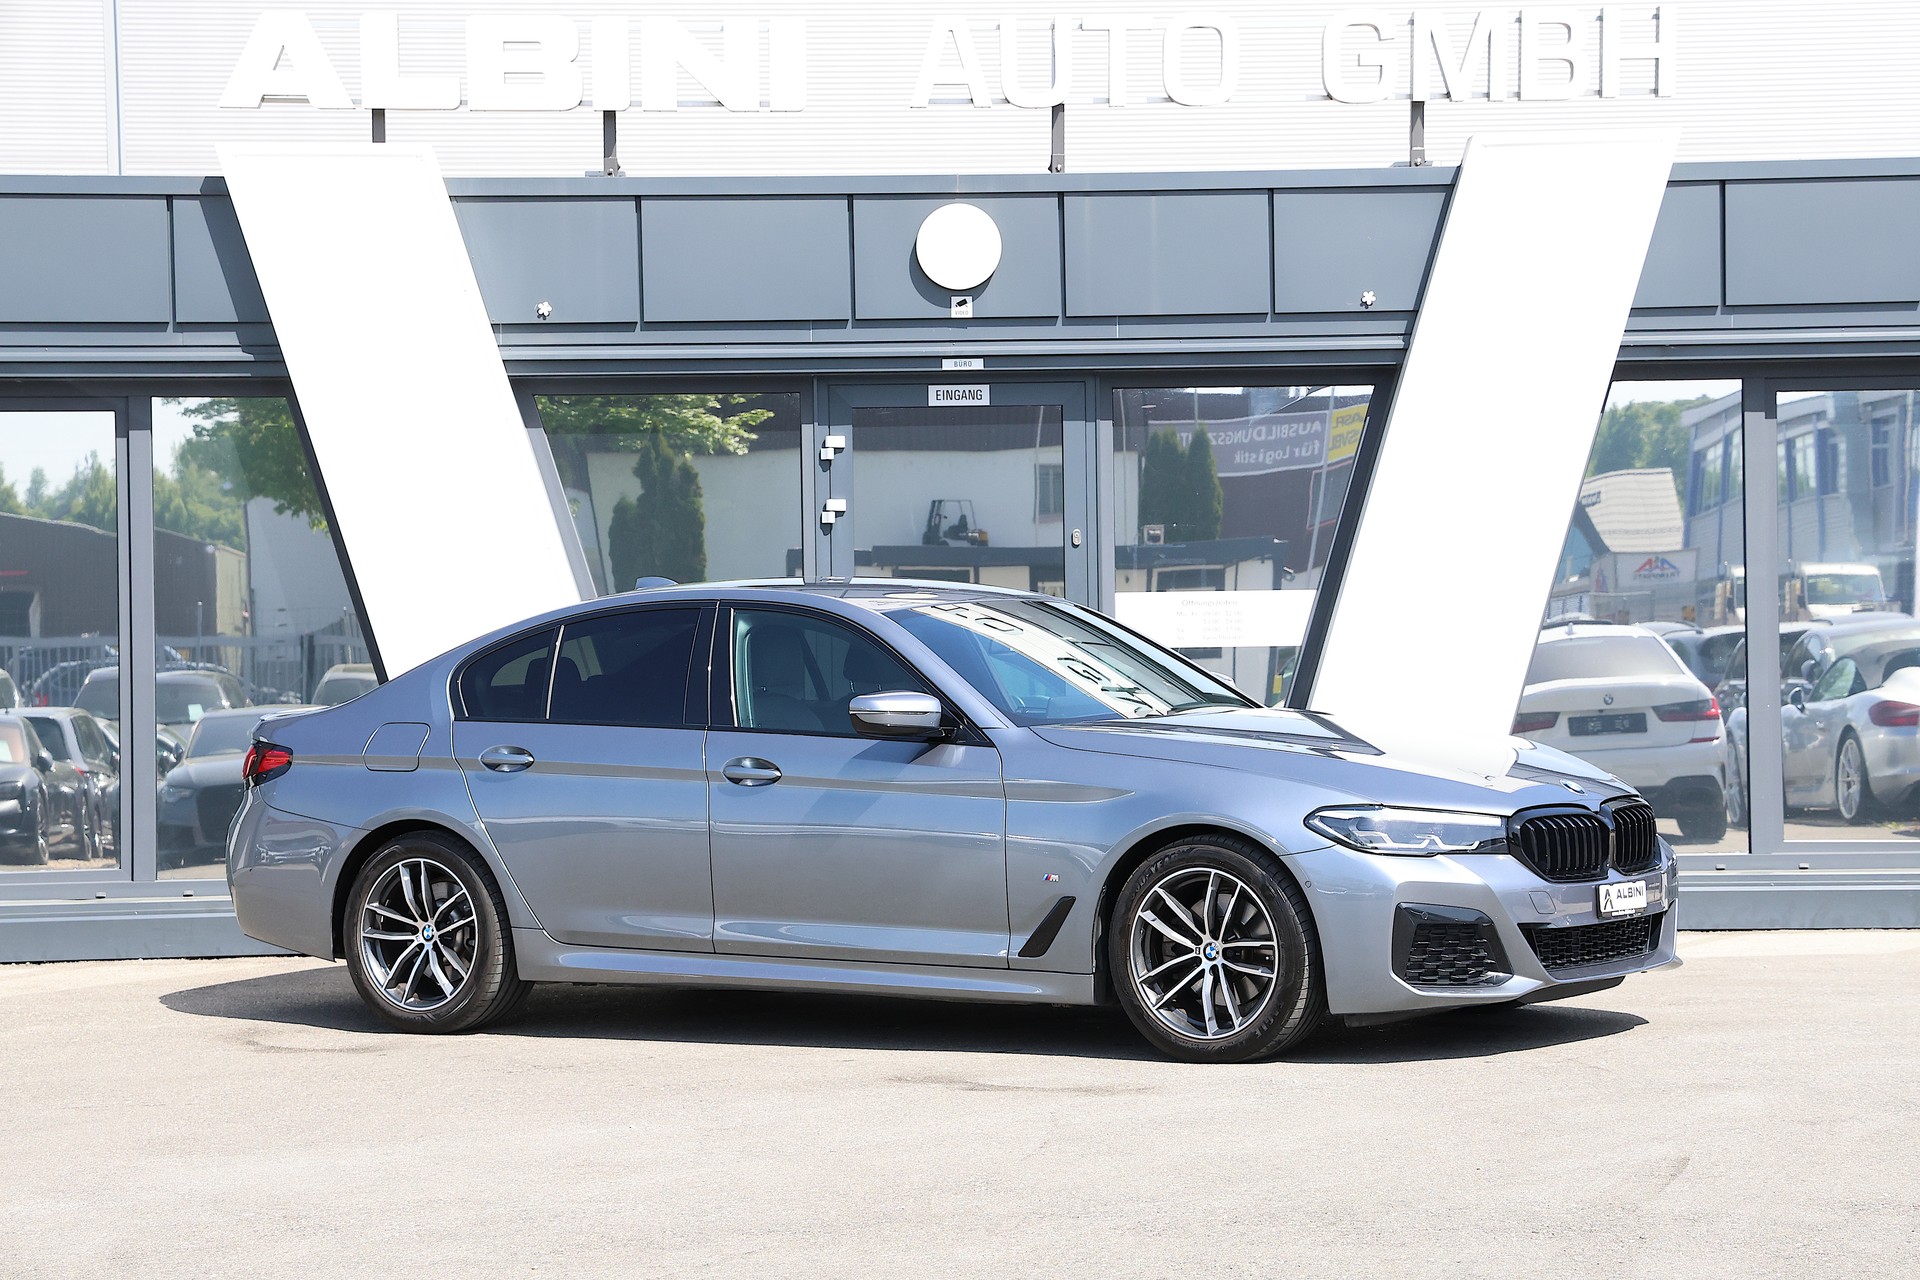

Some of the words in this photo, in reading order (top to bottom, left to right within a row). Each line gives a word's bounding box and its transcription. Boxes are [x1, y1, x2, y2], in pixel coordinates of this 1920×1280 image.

[218, 10, 807, 112] ALBINI
[910, 13, 1240, 109] AUTO
[1320, 4, 1678, 104] GMBH
[935, 389, 983, 401] EINGANG
[1616, 885, 1644, 900] ALBINI
